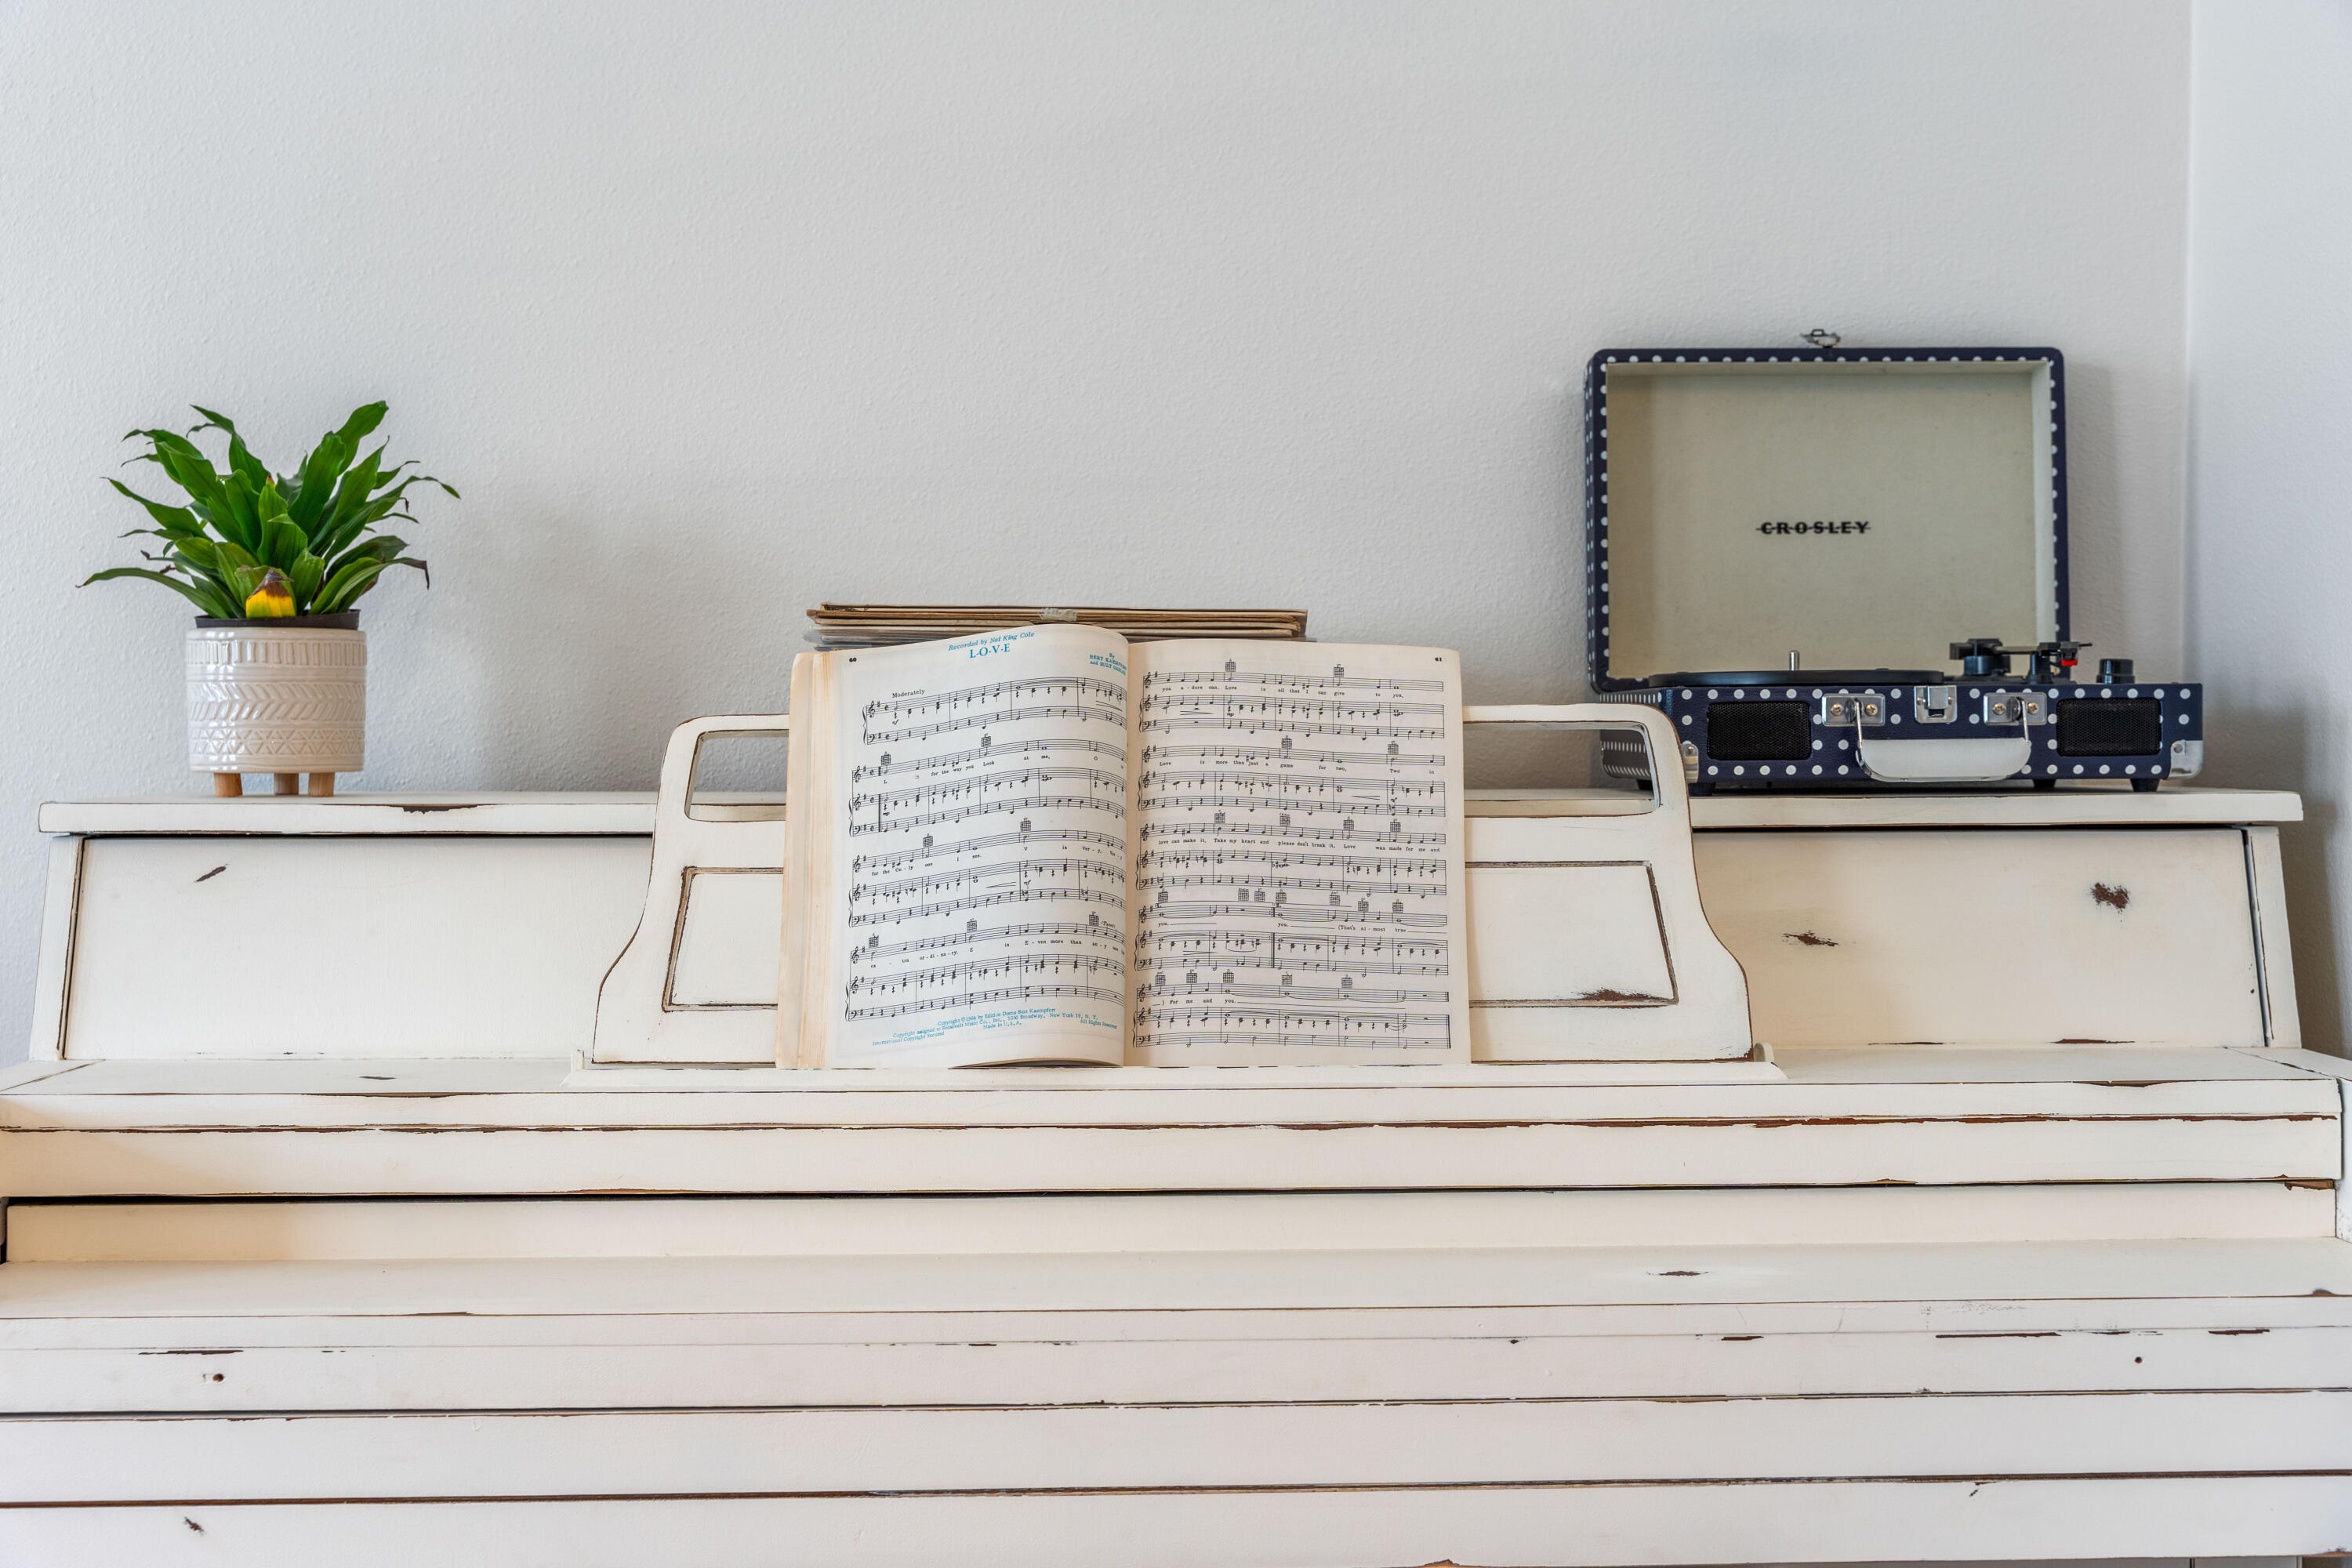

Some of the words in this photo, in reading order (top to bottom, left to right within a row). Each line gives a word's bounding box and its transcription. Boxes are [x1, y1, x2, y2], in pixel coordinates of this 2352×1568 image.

[1758, 521, 1871, 535] CROSLEY
[949, 640, 978, 651] Recorded
[969, 643, 1011, 659] L-O-V-E
[892, 688, 925, 699] Moderately
